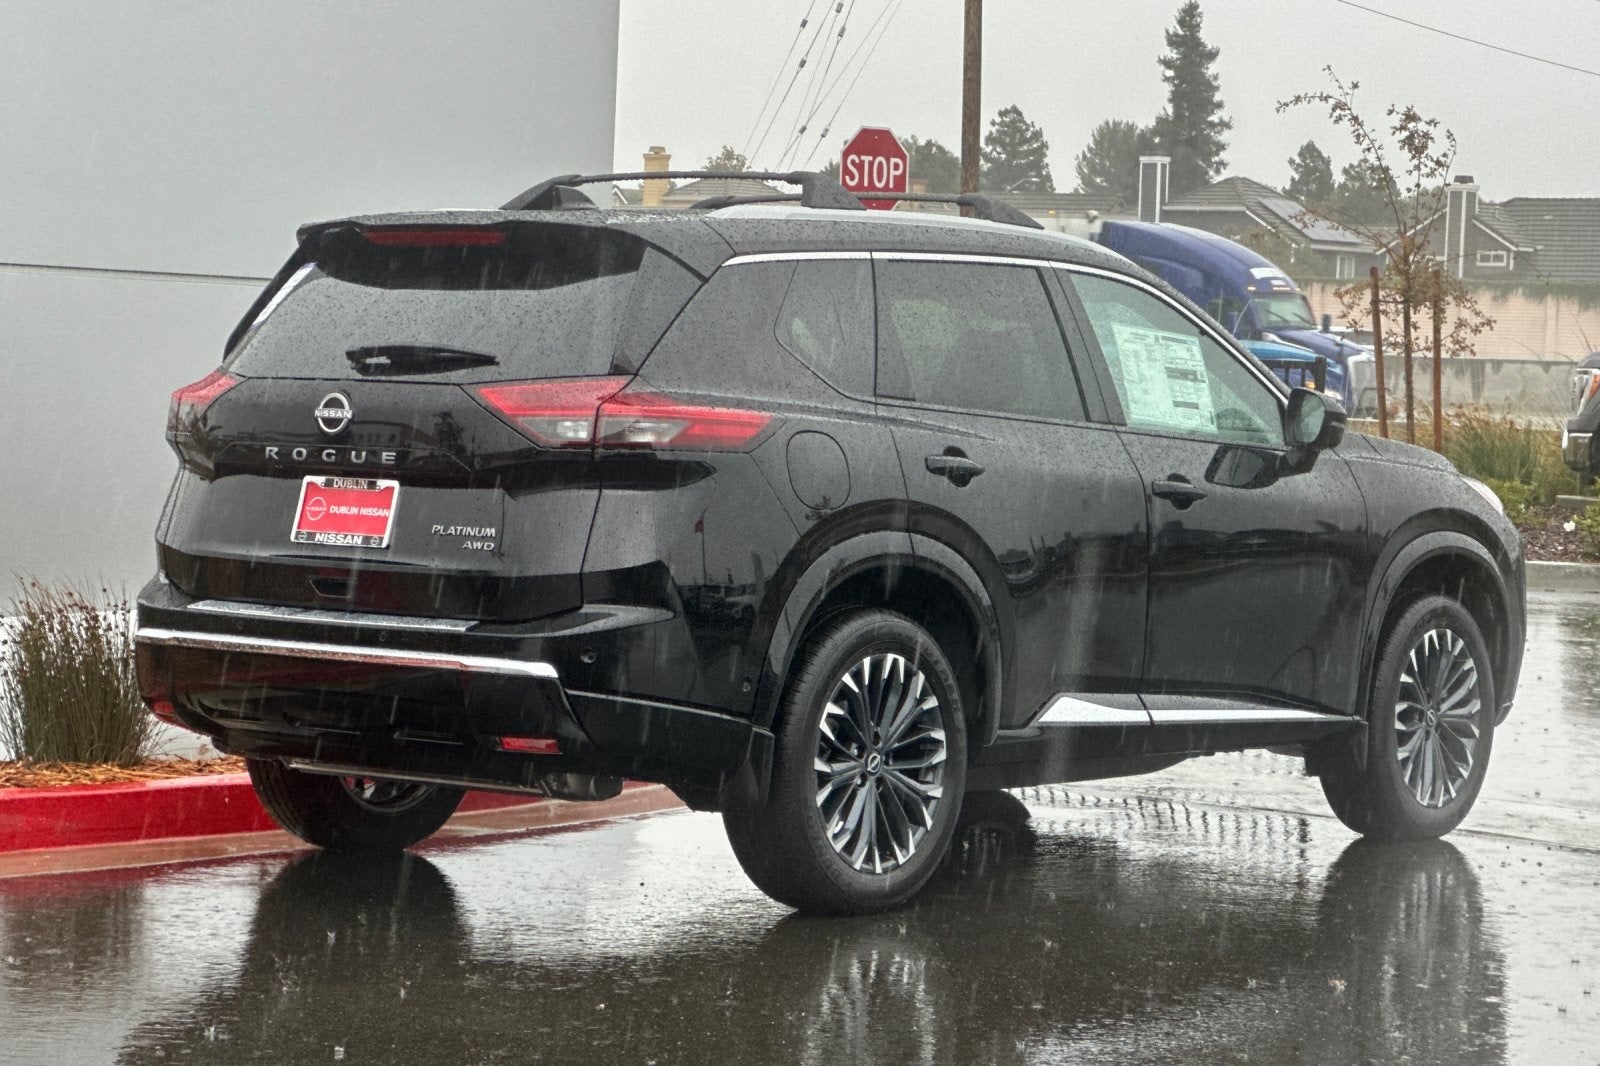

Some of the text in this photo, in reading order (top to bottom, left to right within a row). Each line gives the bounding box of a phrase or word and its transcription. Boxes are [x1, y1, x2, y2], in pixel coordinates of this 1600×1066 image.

[845, 154, 904, 188] STOP
[314, 409, 352, 418] NISSAN
[265, 446, 397, 464] ROGUE
[333, 478, 368, 489] DUBLIN
[329, 505, 390, 517] DUBLIN NISSAN
[431, 524, 496, 537] PLATINUM
[315, 533, 362, 544] NISSAN
[462, 540, 495, 551] AWD
